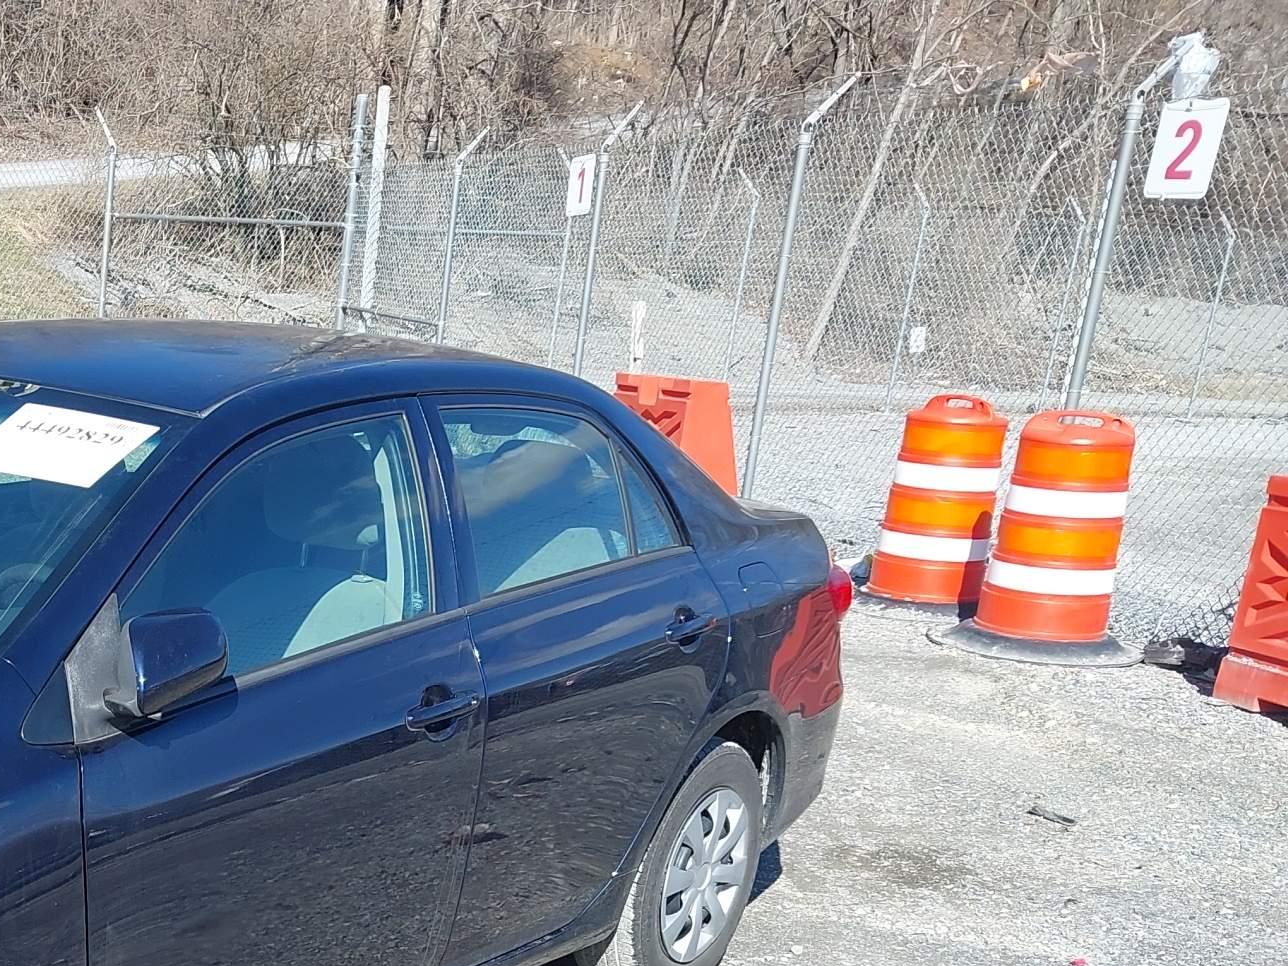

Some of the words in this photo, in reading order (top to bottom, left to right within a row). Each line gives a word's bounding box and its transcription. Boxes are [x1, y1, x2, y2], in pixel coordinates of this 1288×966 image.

[1164, 119, 1203, 180] 2
[577, 167, 585, 204] 1
[16, 420, 123, 445] 44492829
